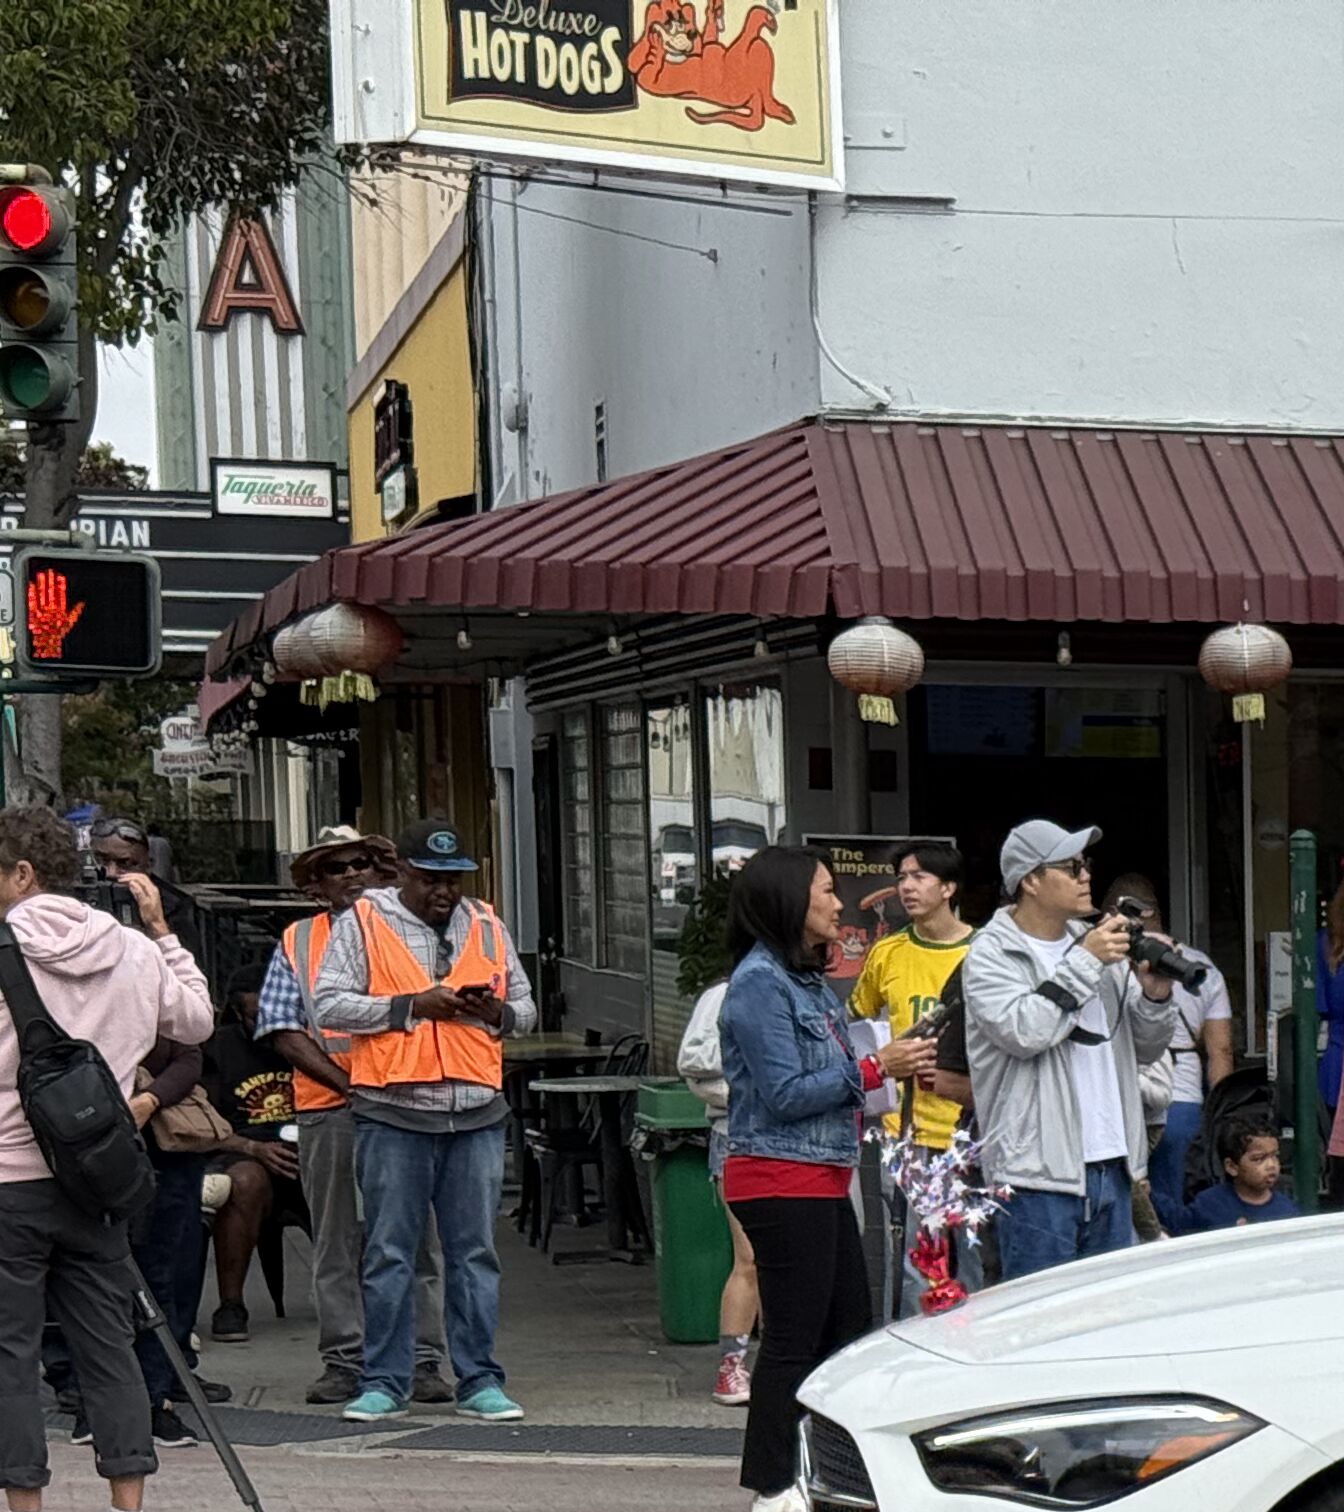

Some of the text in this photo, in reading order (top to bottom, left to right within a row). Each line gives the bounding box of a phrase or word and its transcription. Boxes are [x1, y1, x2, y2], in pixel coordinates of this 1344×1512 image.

[489, 0, 601, 37] Deluxe
[459, 9, 625, 96] HOT DOGS
[199, 208, 305, 335] A
[221, 474, 318, 505] Taqueria
[830, 848, 865, 861] The
[832, 862, 896, 877] ampere
